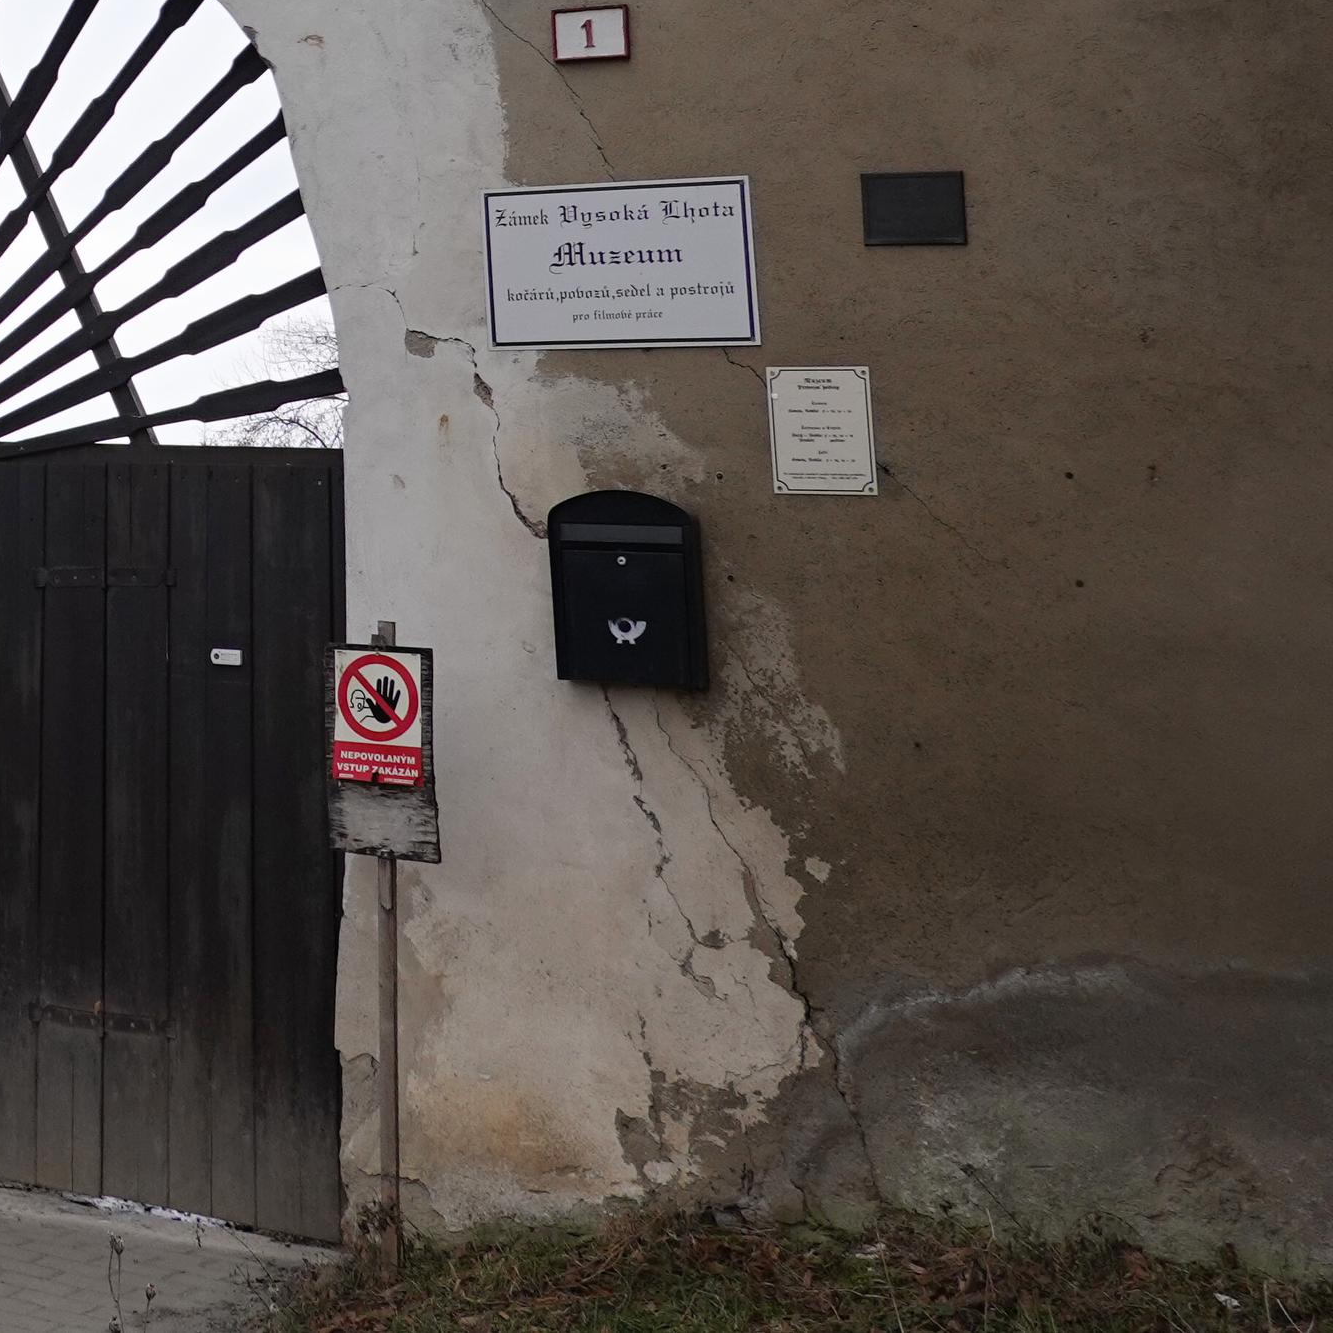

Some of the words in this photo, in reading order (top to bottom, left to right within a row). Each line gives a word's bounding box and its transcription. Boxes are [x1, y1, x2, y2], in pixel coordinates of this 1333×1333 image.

[580, 19, 596, 48] 1
[495, 208, 549, 228] Zámek
[557, 204, 649, 229] Vysoká
[660, 200, 735, 225] Lhota
[548, 242, 683, 275] Muzeum
[656, 287, 664, 297] a
[669, 281, 734, 300] postrojů
[572, 312, 590, 323] pro
[594, 309, 633, 320] filmové
[635, 309, 663, 322] práce
[340, 750, 416, 765] NEPOVOLANÝM
[337, 762, 369, 773] VSTUP
[372, 765, 418, 778] ZAKÁZÁN
